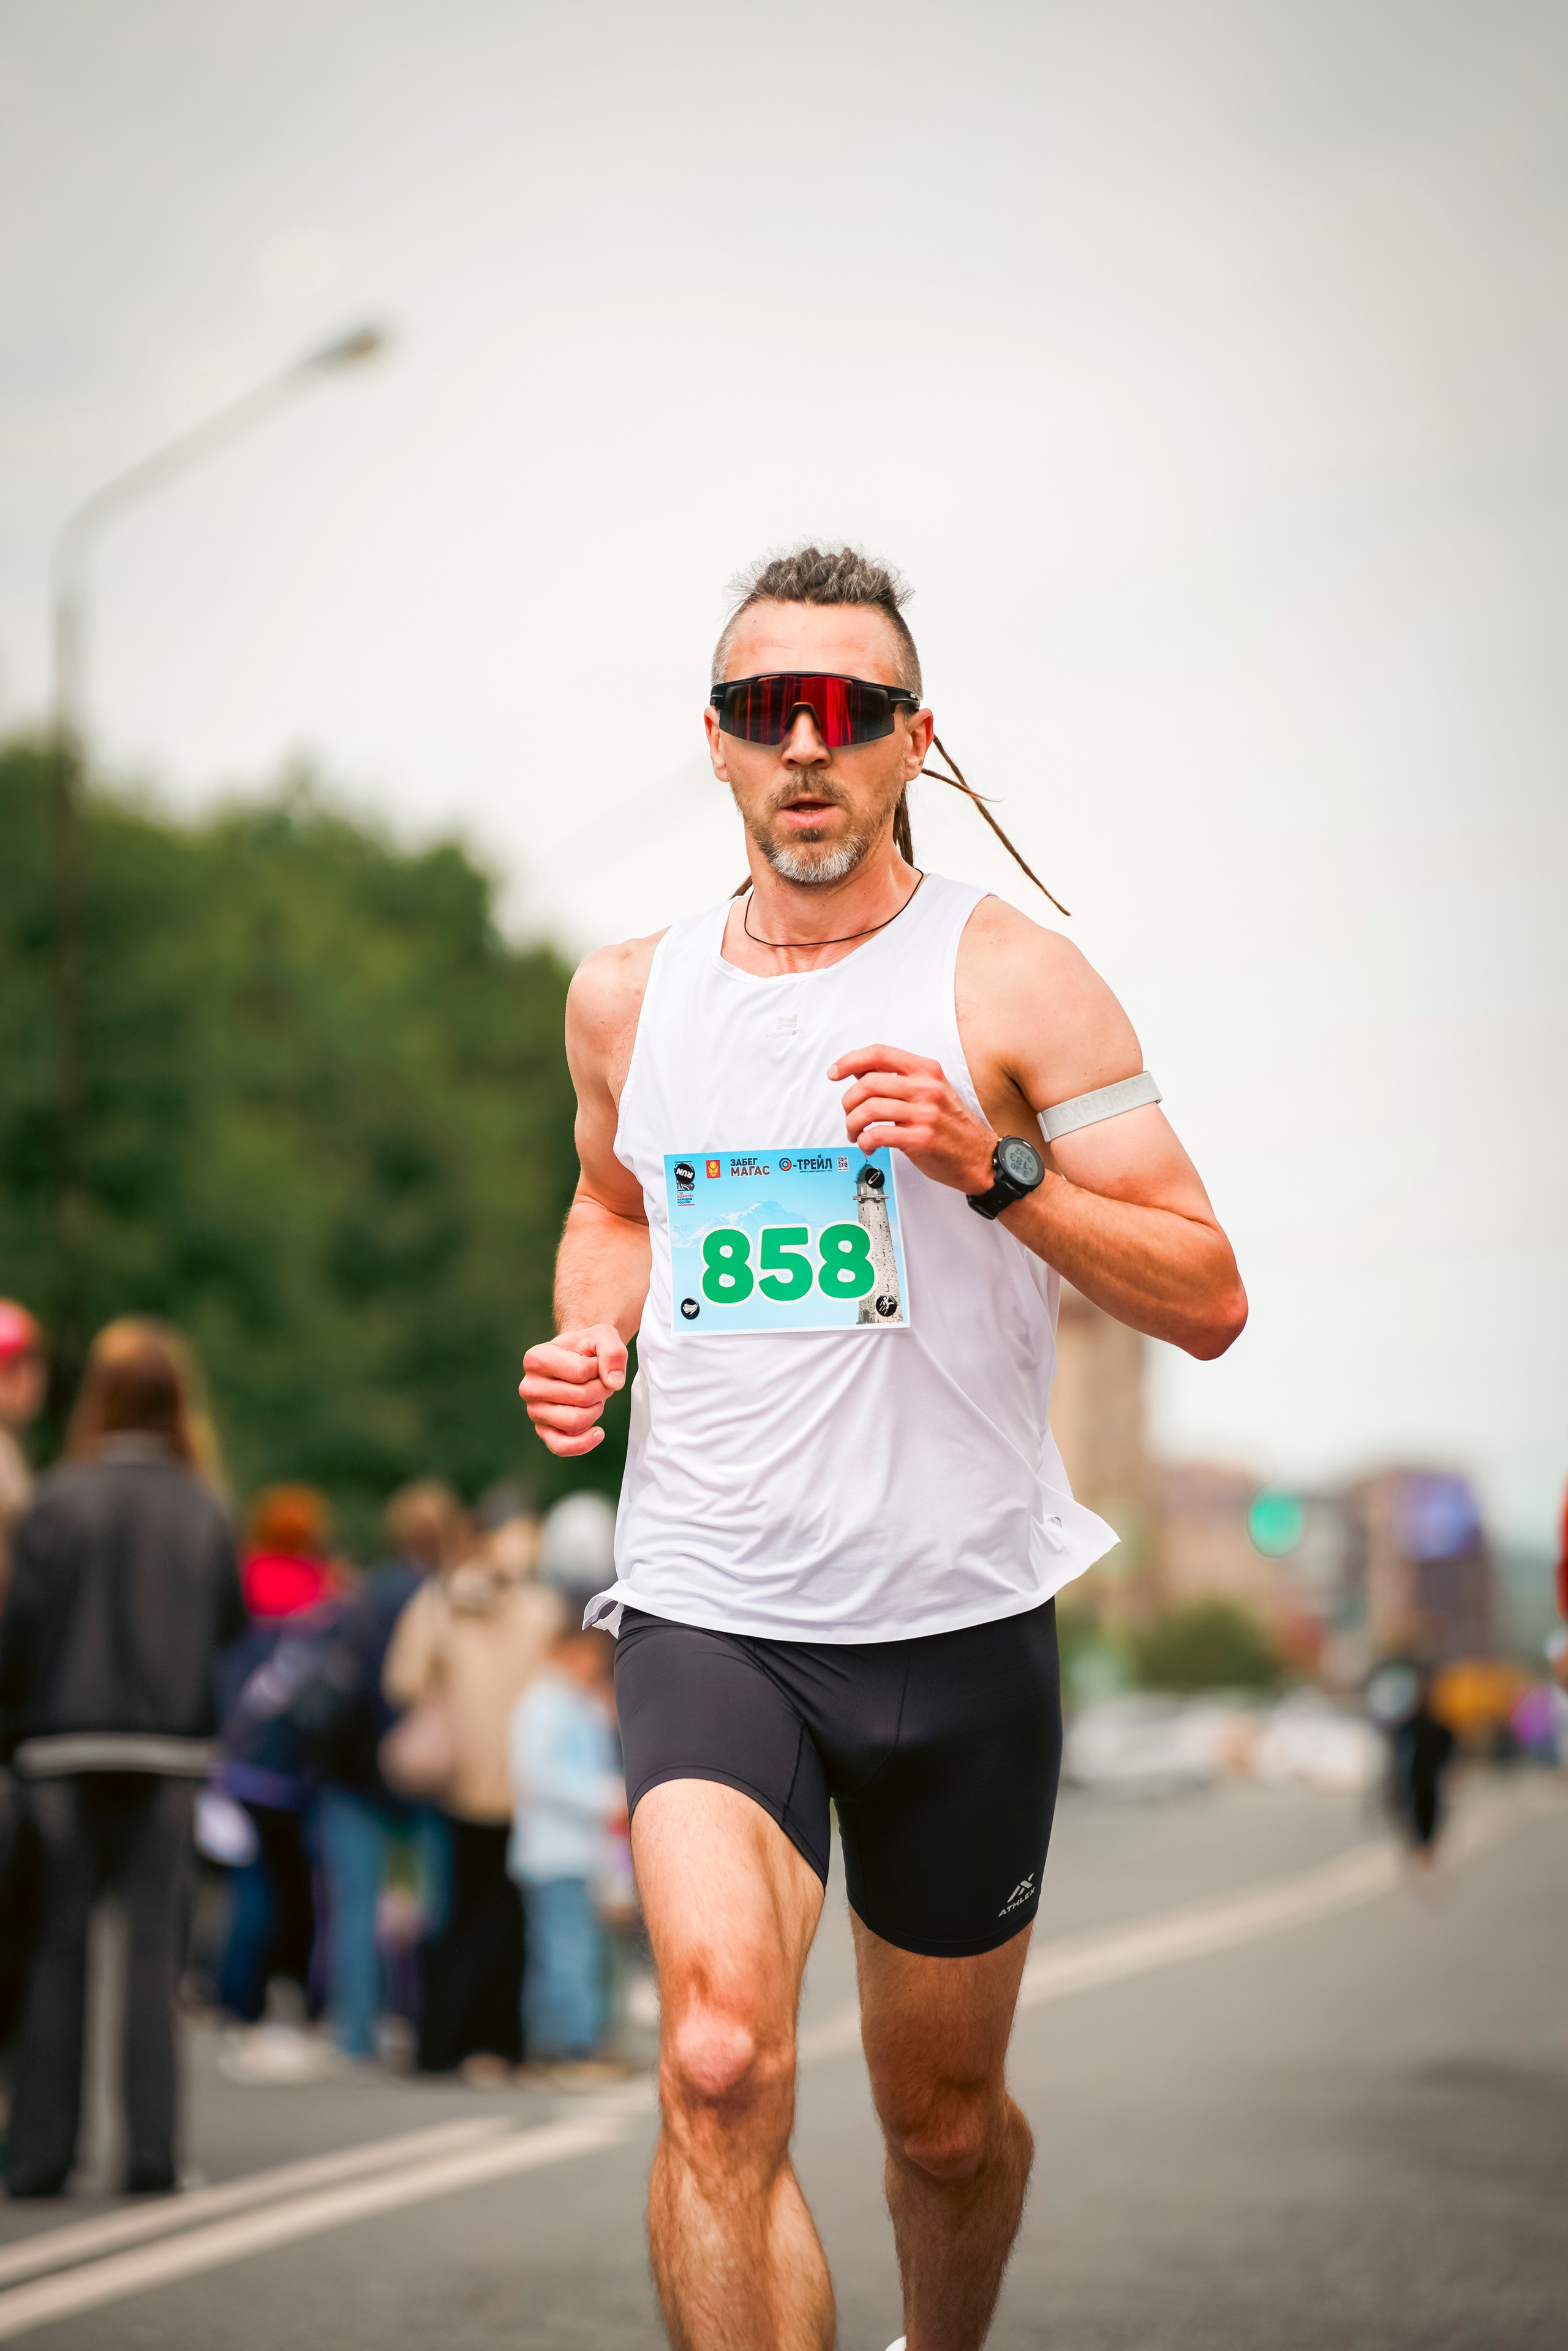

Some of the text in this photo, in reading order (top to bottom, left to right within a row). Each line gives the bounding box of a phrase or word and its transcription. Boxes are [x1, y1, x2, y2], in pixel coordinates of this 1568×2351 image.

[765, 1027, 805, 1039] NORDSKI
[730, 1158, 758, 1166] ЗАБЕГ
[676, 1168, 694, 1179] RUN
[731, 1166, 770, 1177] МАГАС
[701, 1223, 876, 1304] 858
[998, 1887, 1036, 1917] ATHLEX
